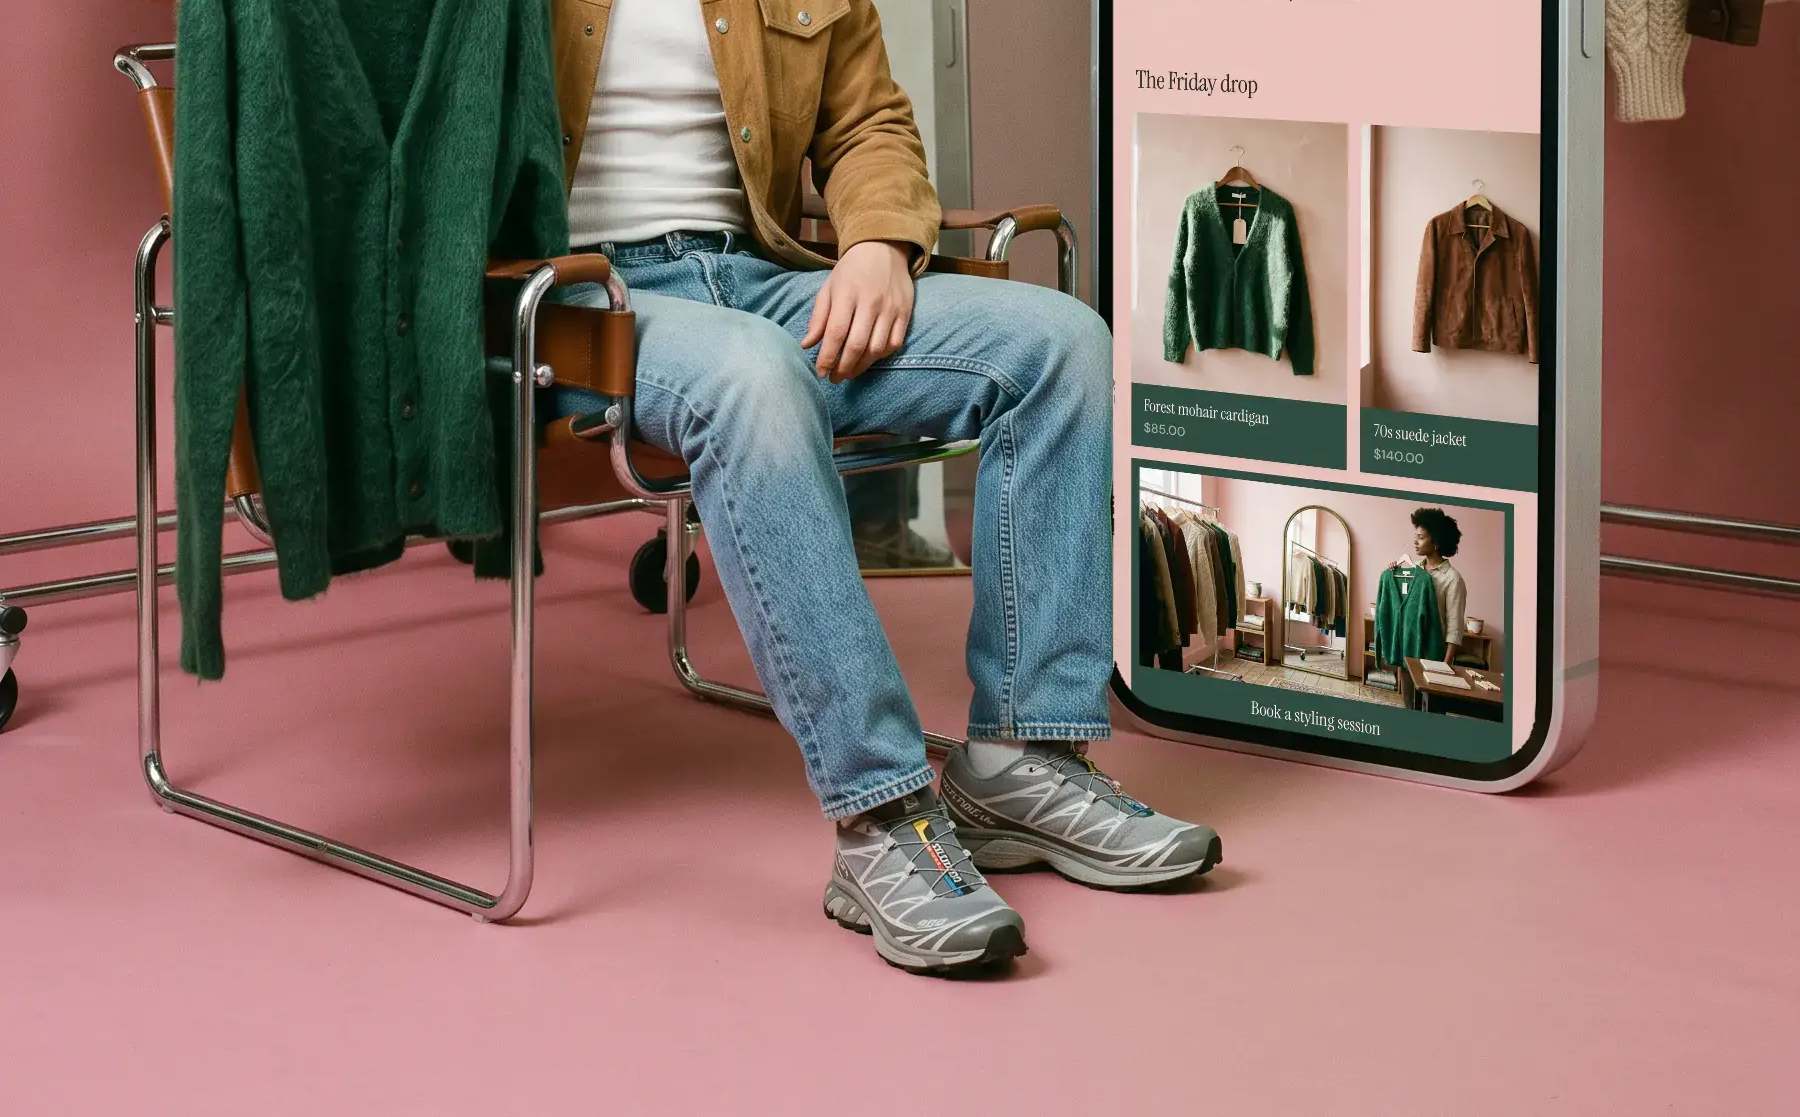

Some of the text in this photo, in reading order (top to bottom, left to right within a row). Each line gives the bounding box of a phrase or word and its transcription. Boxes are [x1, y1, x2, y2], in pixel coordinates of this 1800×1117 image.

[1135, 69, 1258, 99] The Friday drop
[1143, 398, 1269, 427] Forest mohair cardigan
[1143, 421, 1186, 437] $85.00
[1373, 423, 1467, 448] 70s suede jacket
[1373, 447, 1424, 465] $140.00
[1250, 700, 1381, 736] Book a styling session
